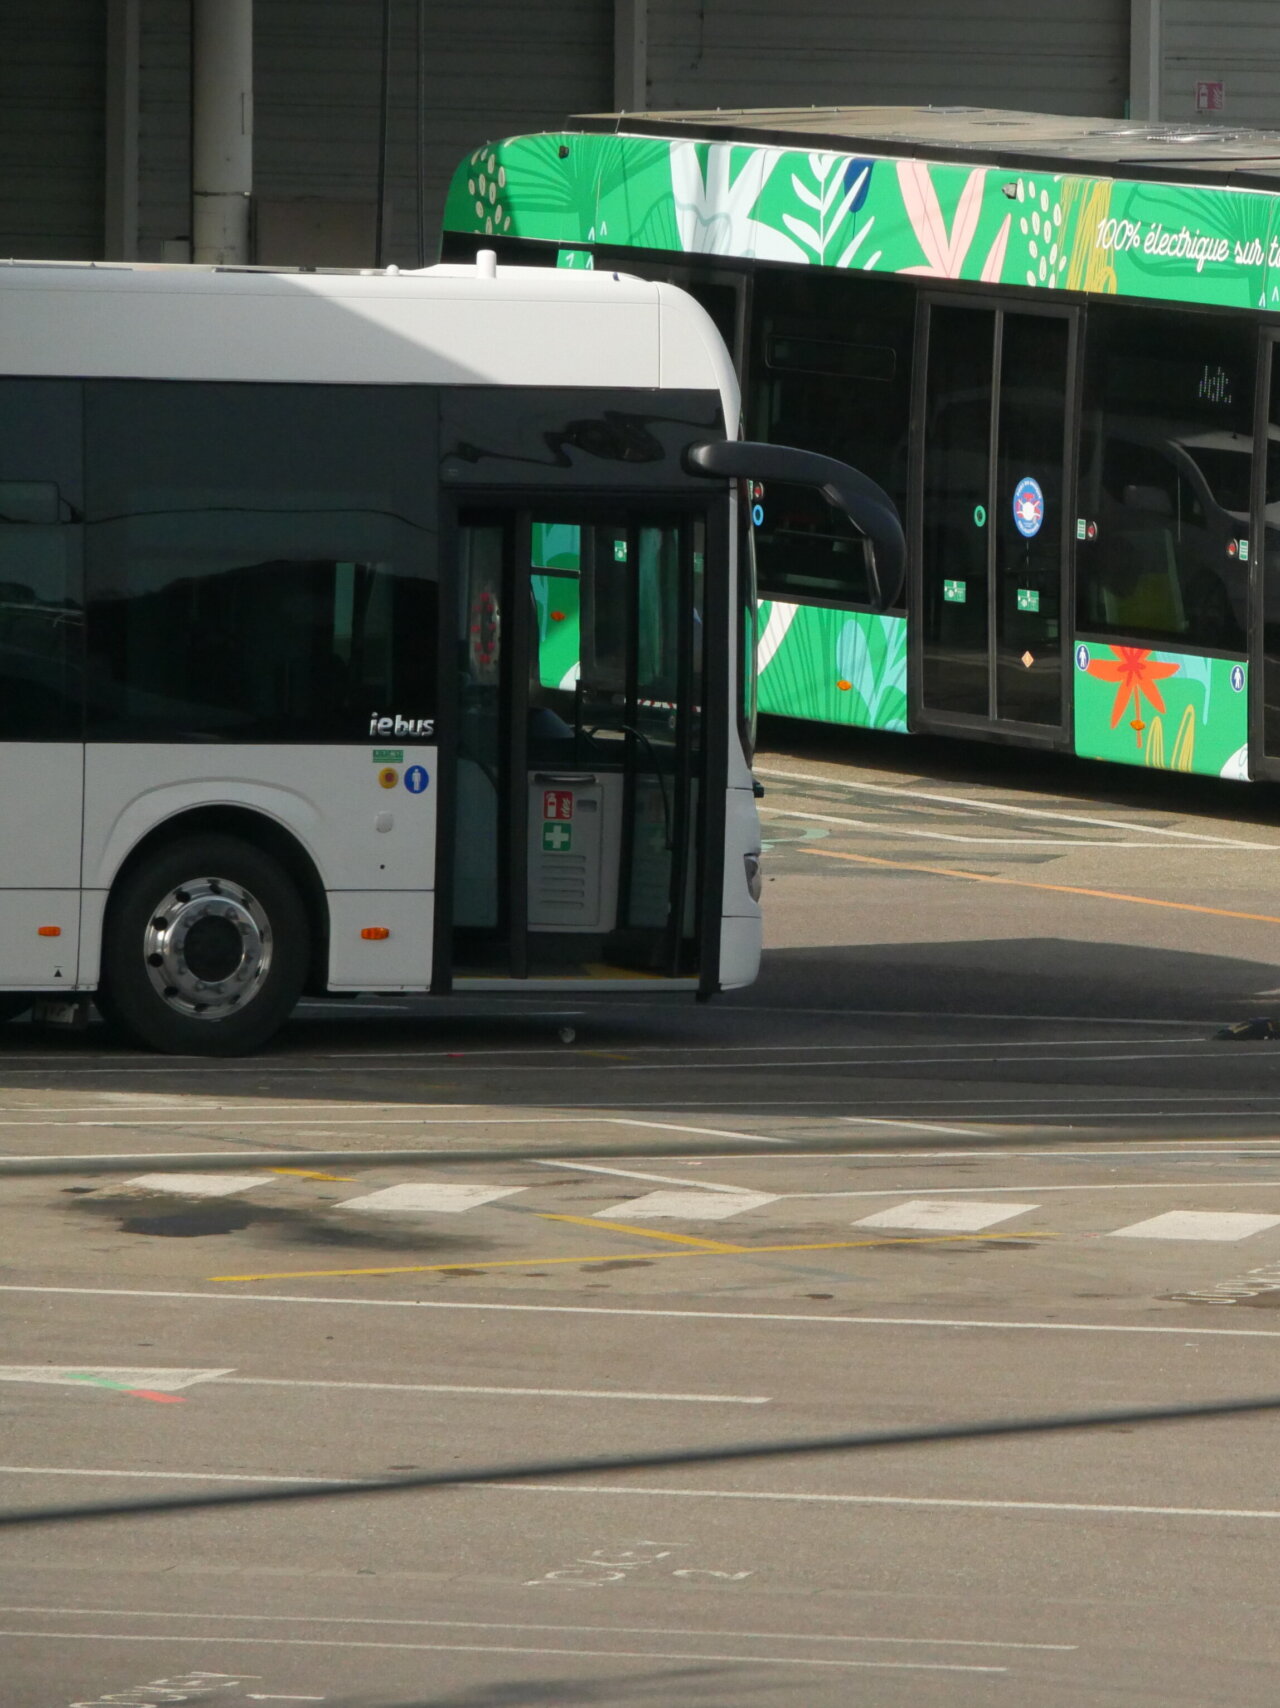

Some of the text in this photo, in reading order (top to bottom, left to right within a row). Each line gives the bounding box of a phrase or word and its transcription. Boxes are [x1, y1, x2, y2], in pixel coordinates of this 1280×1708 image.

[1095, 218, 1141, 250] 100%
[1143, 223, 1229, 272] électrique
[1234, 236, 1265, 265] sur
